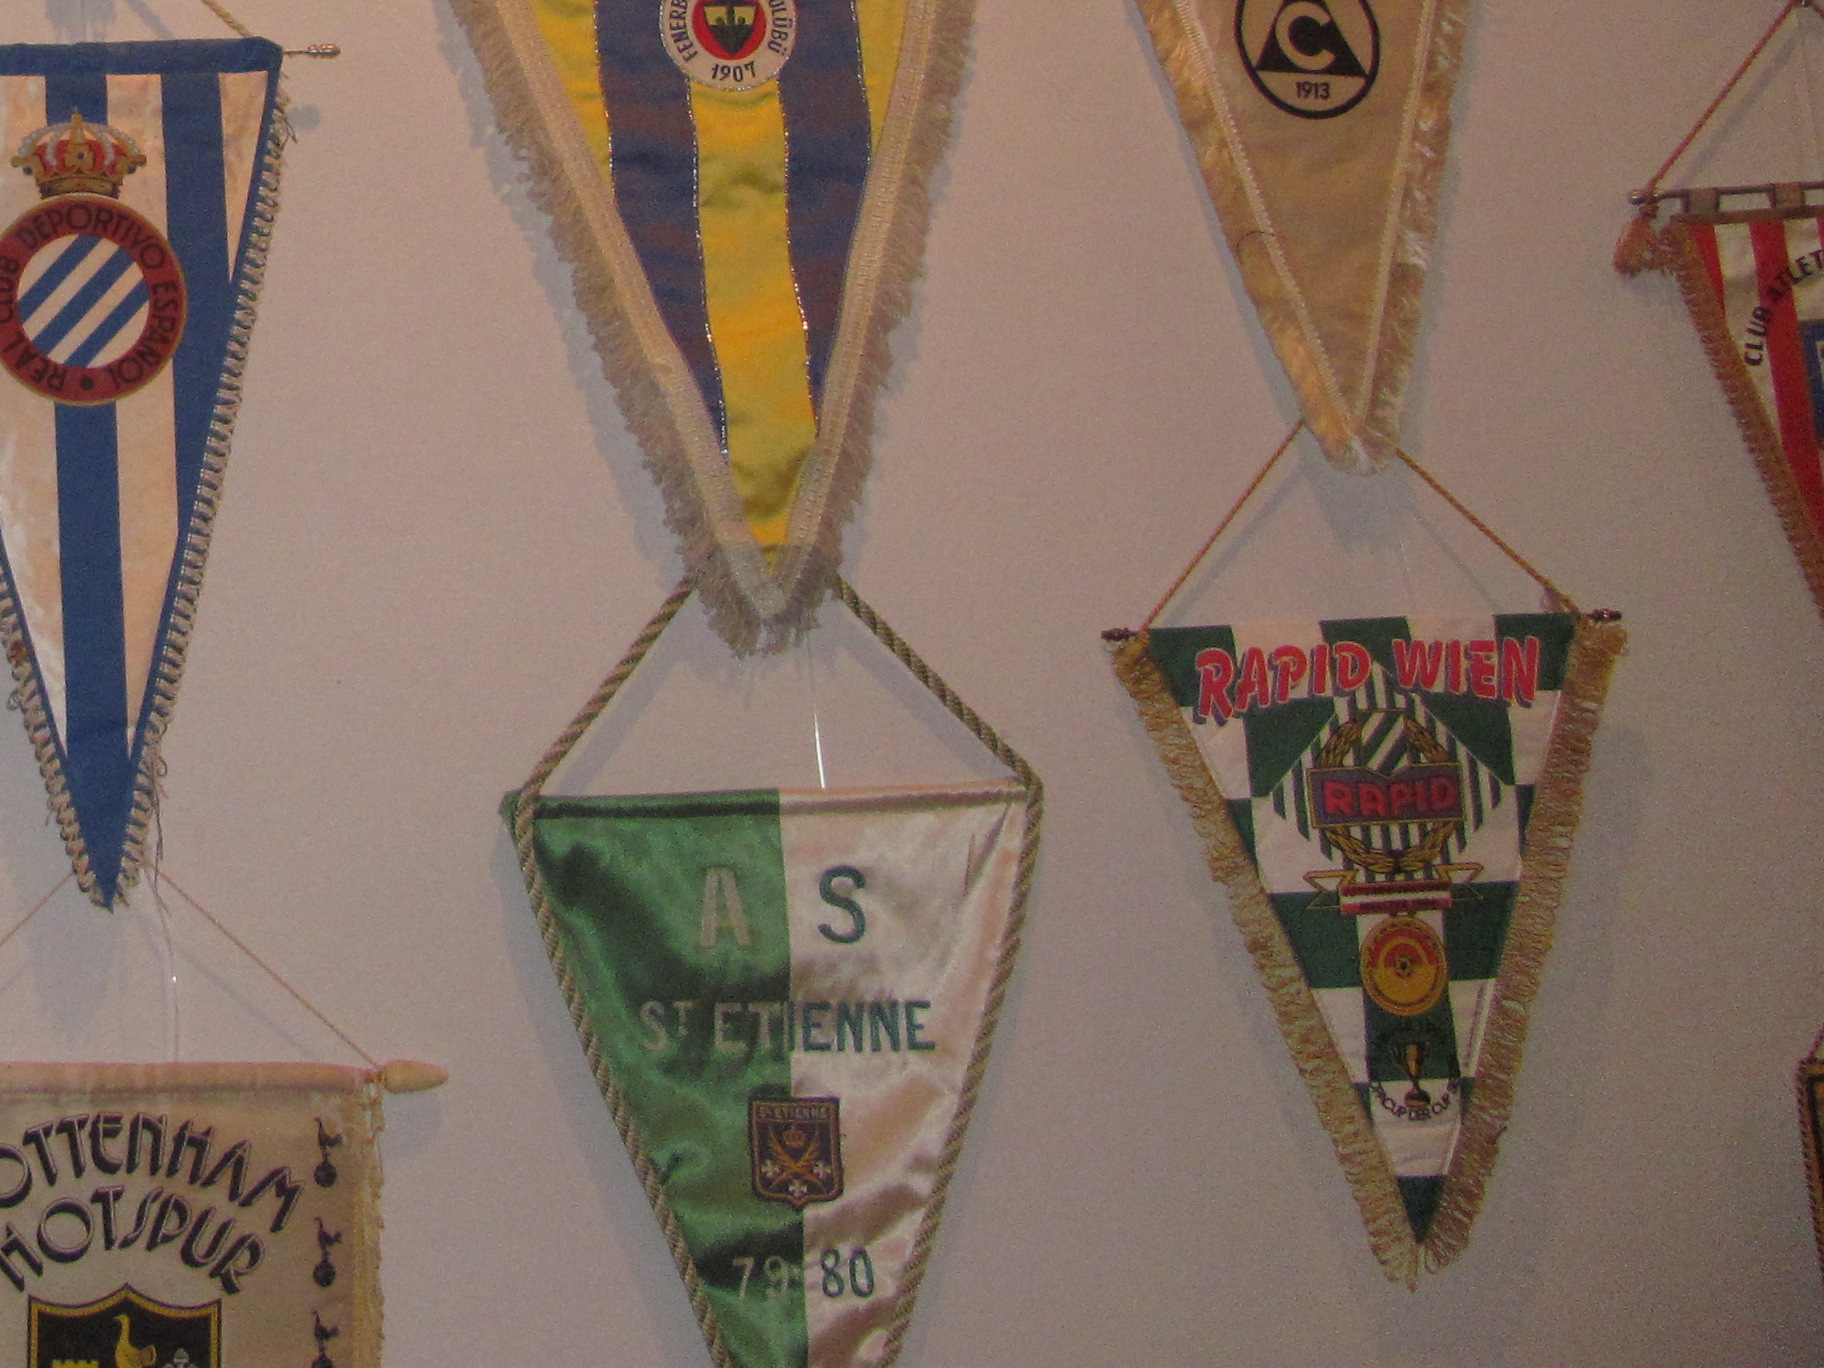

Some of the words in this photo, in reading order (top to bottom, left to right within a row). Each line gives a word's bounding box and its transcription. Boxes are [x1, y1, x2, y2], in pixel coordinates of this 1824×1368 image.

[711, 60, 758, 83] 1907
[1295, 82, 1331, 100] 1913
[16, 203, 166, 270] DEPORTIVO
[1193, 642, 1372, 725] RAPID
[1392, 637, 1541, 708] WIEN
[1322, 779, 1458, 819] RAPID
[699, 868, 753, 948] A
[817, 863, 867, 945] S
[714, 998, 937, 1055] ETIENNE
[819, 1248, 876, 1299] 80
